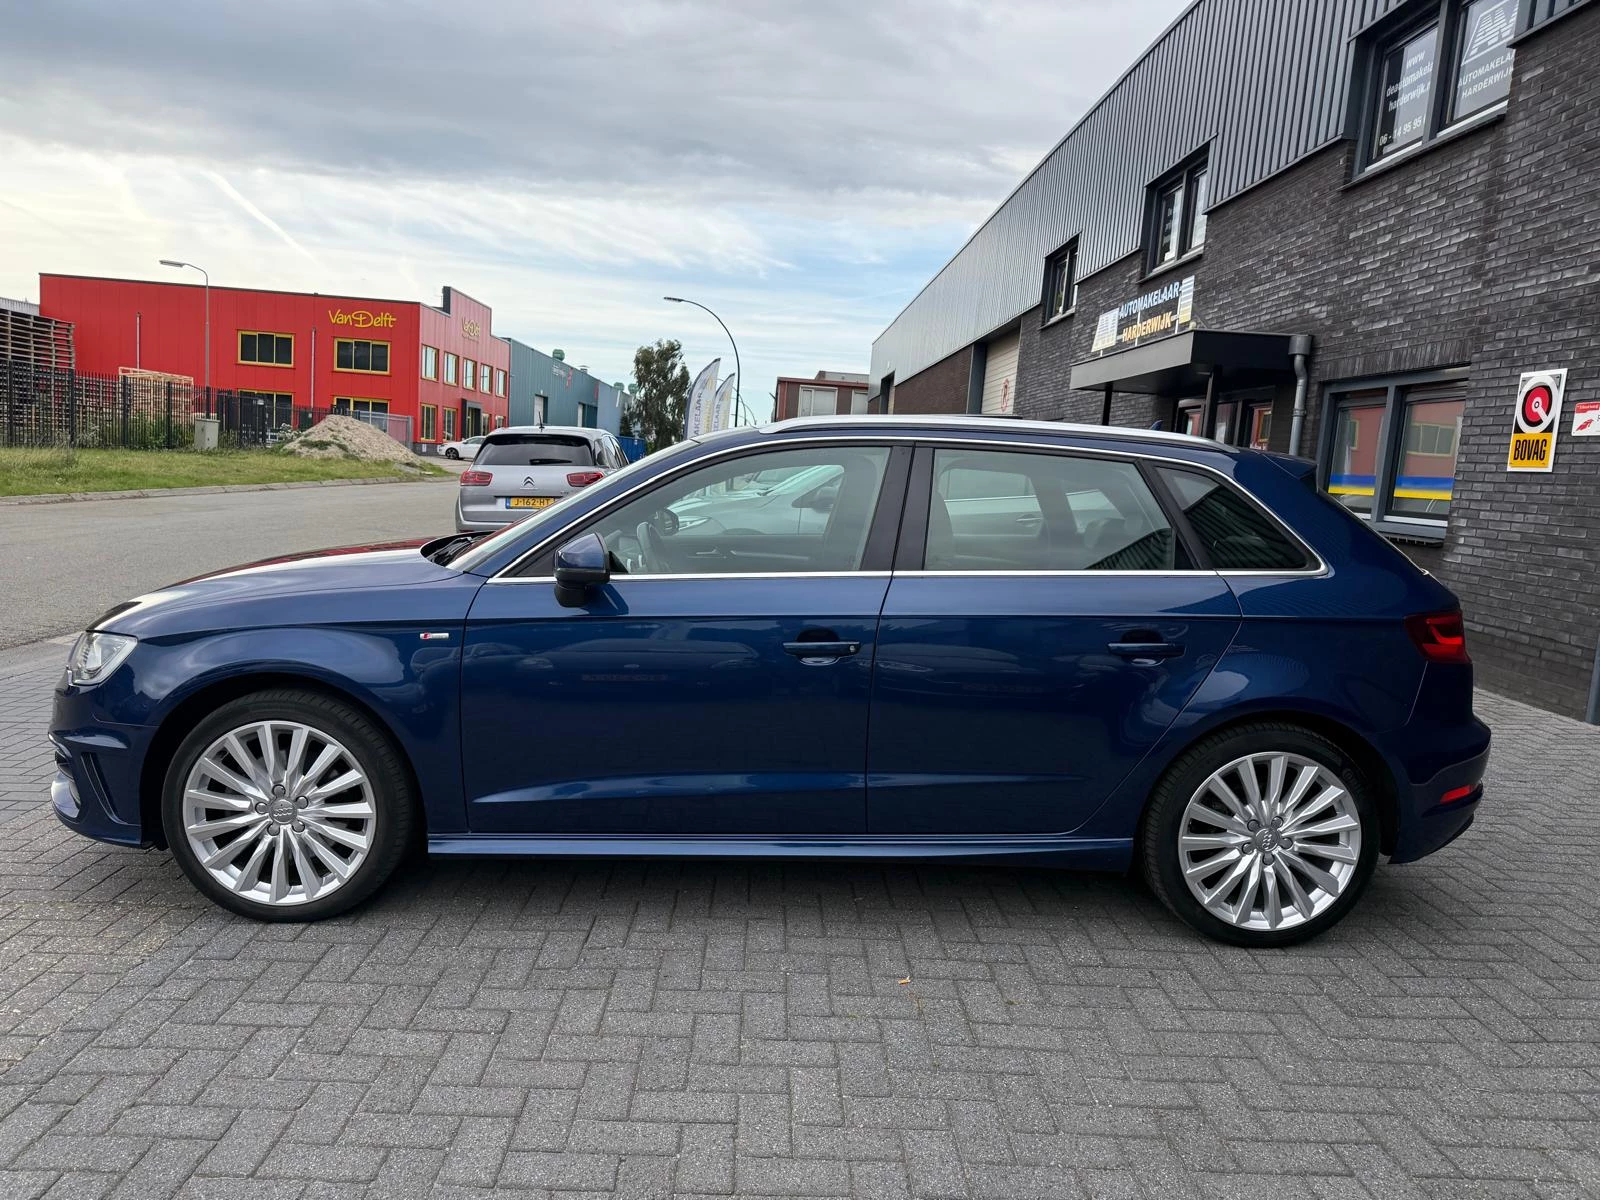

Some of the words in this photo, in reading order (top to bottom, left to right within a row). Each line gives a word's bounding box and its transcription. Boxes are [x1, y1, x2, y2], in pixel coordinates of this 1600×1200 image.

[1119, 281, 1180, 319] AUTOMAKELAAR
[1121, 311, 1172, 343] HARDERWIJK
[1513, 438, 1548, 461] BOVAG
